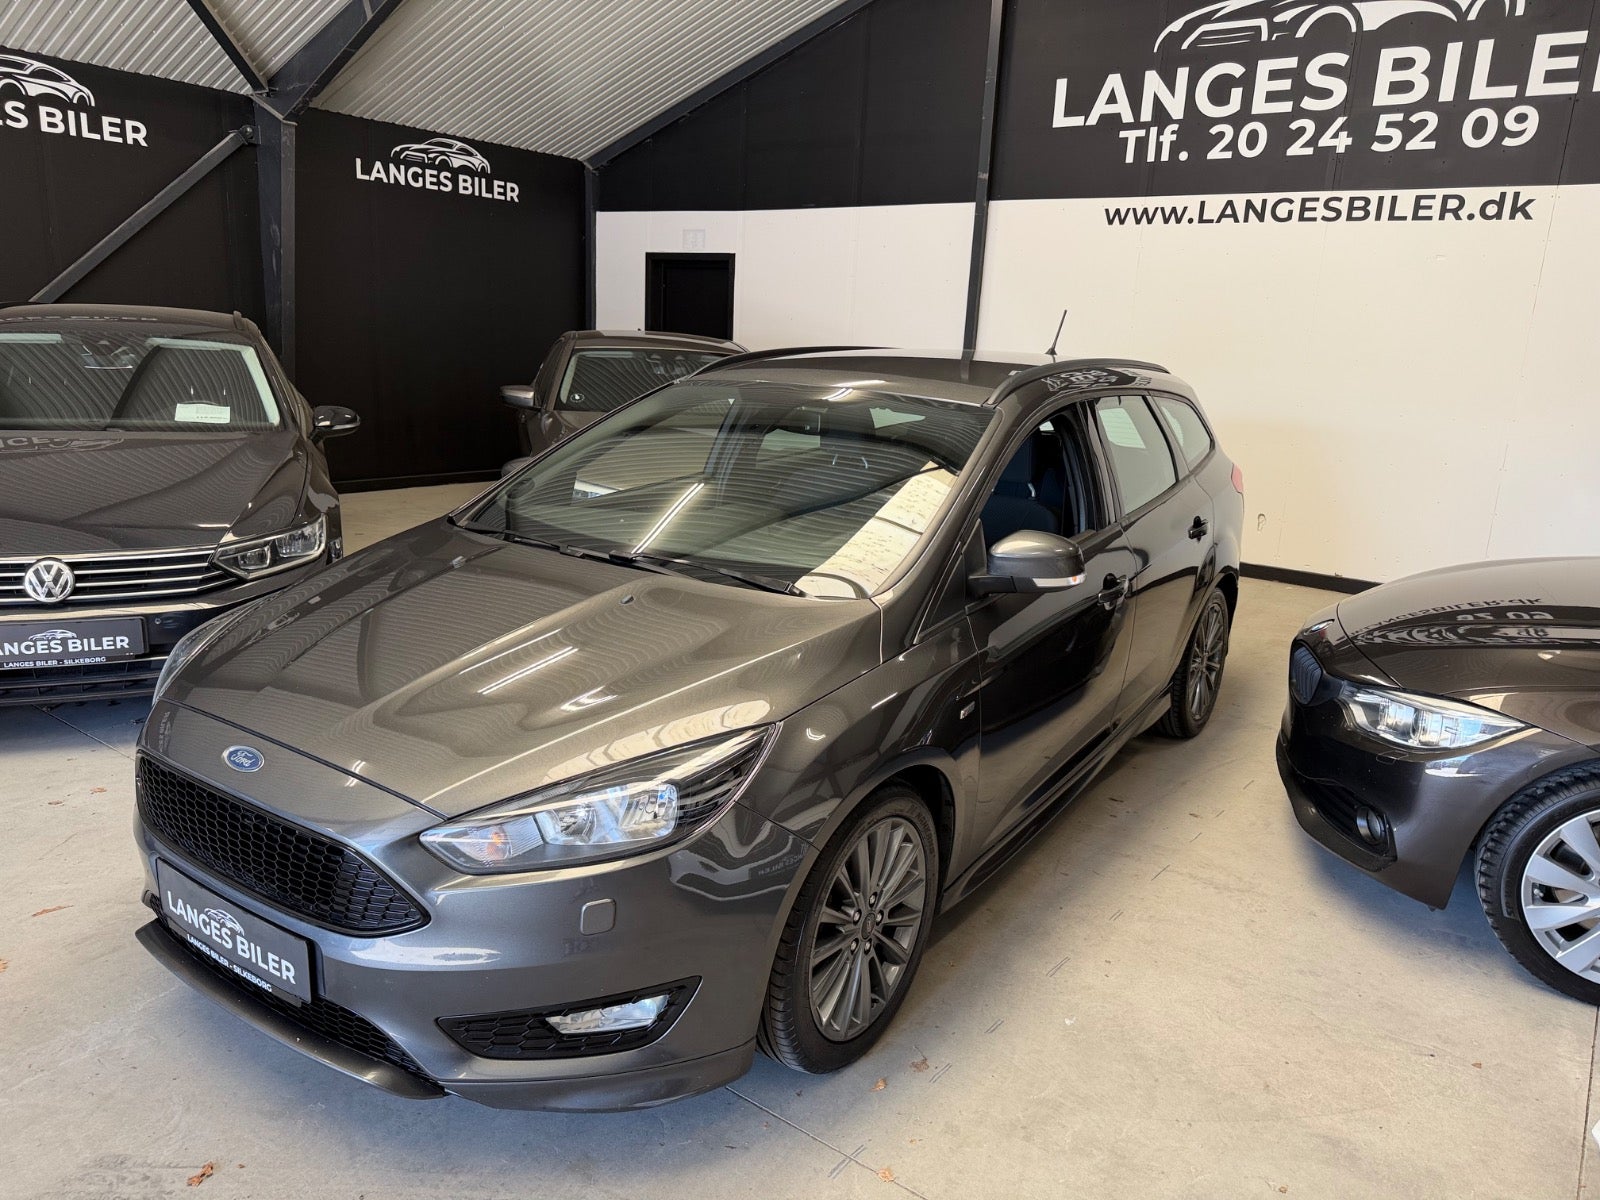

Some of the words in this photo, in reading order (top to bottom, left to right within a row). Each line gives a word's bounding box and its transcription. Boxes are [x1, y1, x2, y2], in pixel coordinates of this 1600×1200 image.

[1051, 52, 1351, 128] LANGES
[1371, 30, 1600, 107] BILE
[38, 104, 149, 147] BILER
[1119, 126, 1189, 164] Tlf.
[1206, 121, 1268, 160] 20
[1285, 116, 1353, 156] 24
[1370, 111, 1439, 152] 52
[1460, 105, 1540, 149] 09
[355, 157, 453, 192] LANGES
[458, 174, 520, 203] BILER
[1104, 191, 1537, 226] www.LANGESBILER.dk
[0, 639, 63, 656] NGES
[68, 635, 130, 653] BILER
[36, 659, 58, 667] BILER
[63, 656, 107, 665] SILKEBORG
[230, 749, 257, 767] Ford
[167, 890, 233, 949] LANGES
[236, 934, 296, 984] BILER
[187, 933, 211, 955] LANGES
[209, 950, 229, 968] BILER
[233, 964, 273, 992] SILKEBORG
